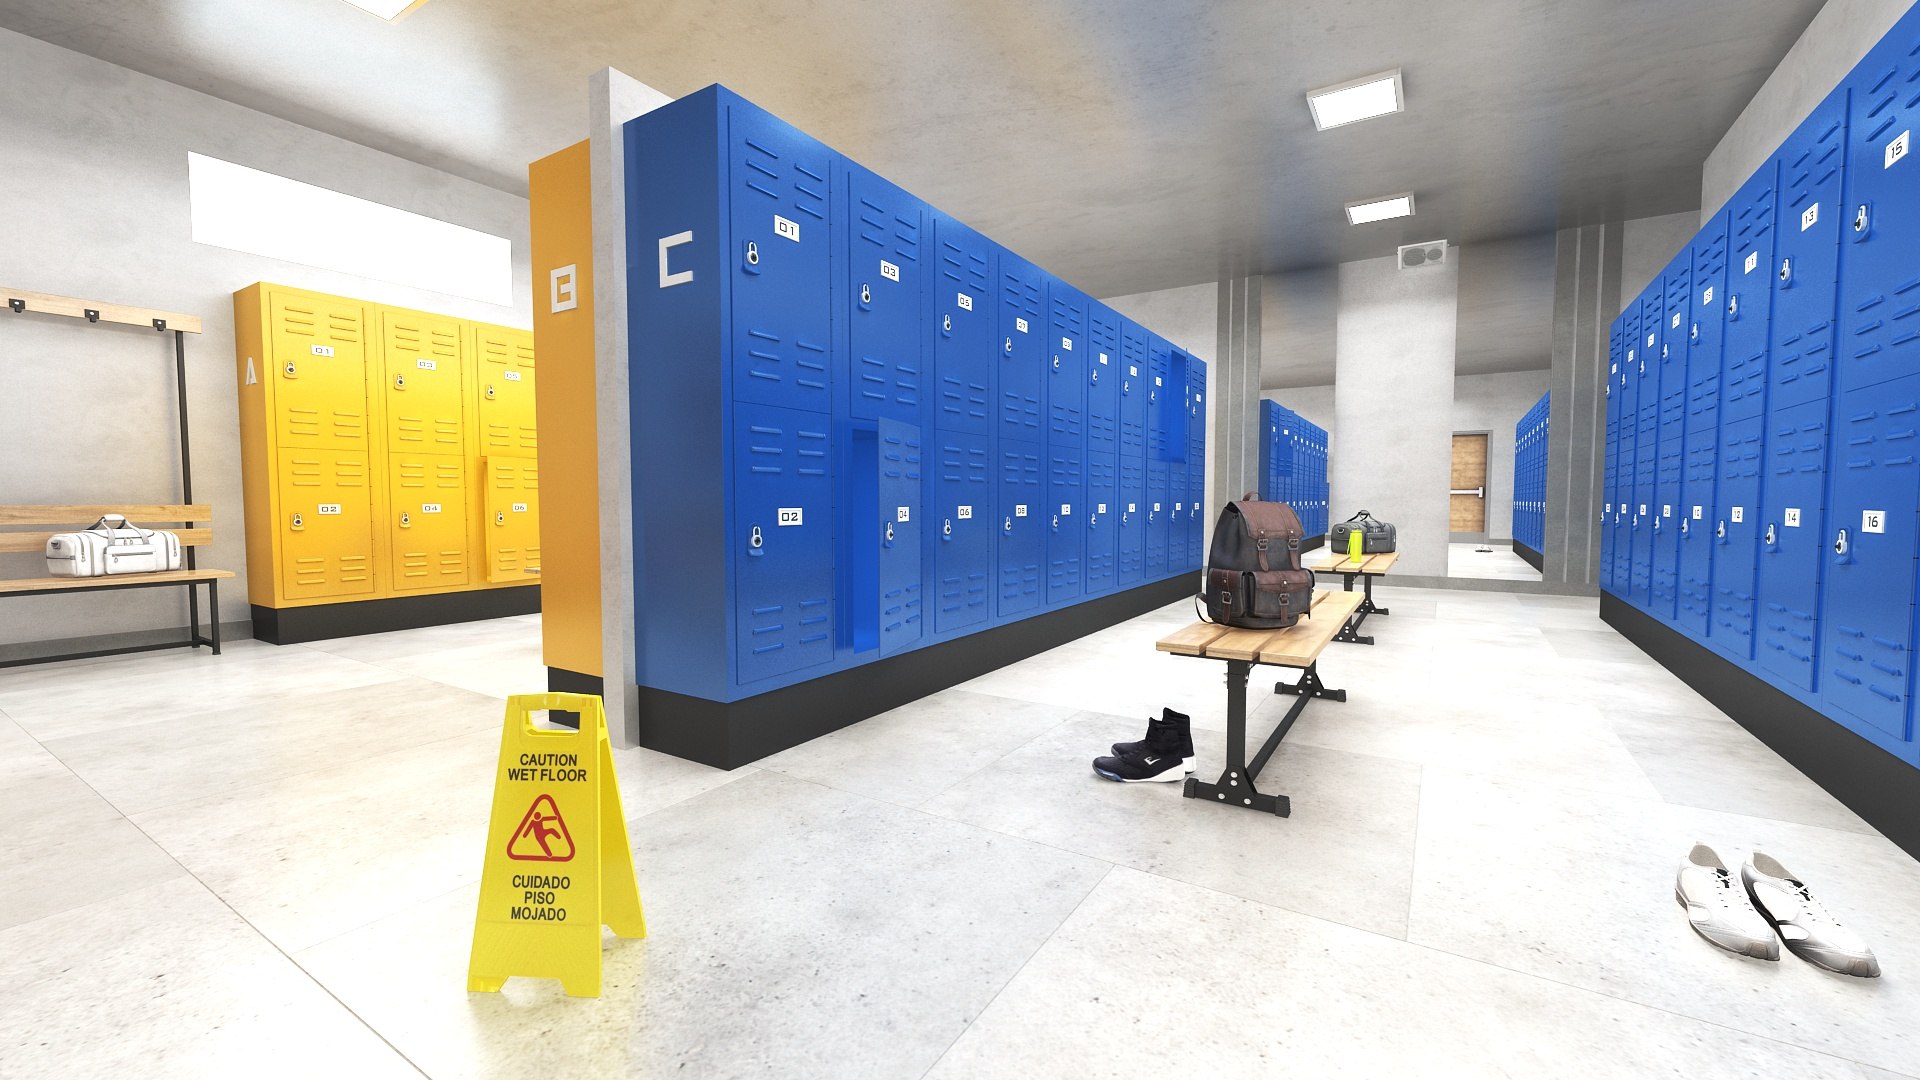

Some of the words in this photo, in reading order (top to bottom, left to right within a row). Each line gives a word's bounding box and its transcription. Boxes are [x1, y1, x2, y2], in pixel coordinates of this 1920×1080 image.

[1891, 141, 1903, 159] 15
[1805, 210, 1814, 224] 13
[779, 221, 794, 236] 01
[659, 230, 693, 289] C
[883, 265, 896, 277] 03
[959, 297, 970, 307] 05
[245, 357, 257, 386] A
[782, 512, 798, 522] 02
[899, 510, 907, 519] 04
[959, 508, 969, 516] 06
[1788, 512, 1797, 523] 14
[1868, 515, 1878, 528] 16
[519, 753, 578, 767] CAUTION
[508, 768, 538, 782] WET
[540, 768, 587, 782] FLOOR
[512, 874, 571, 890] CUIDADO
[524, 891, 555, 905] PISO
[510, 906, 567, 922] MOJADO
